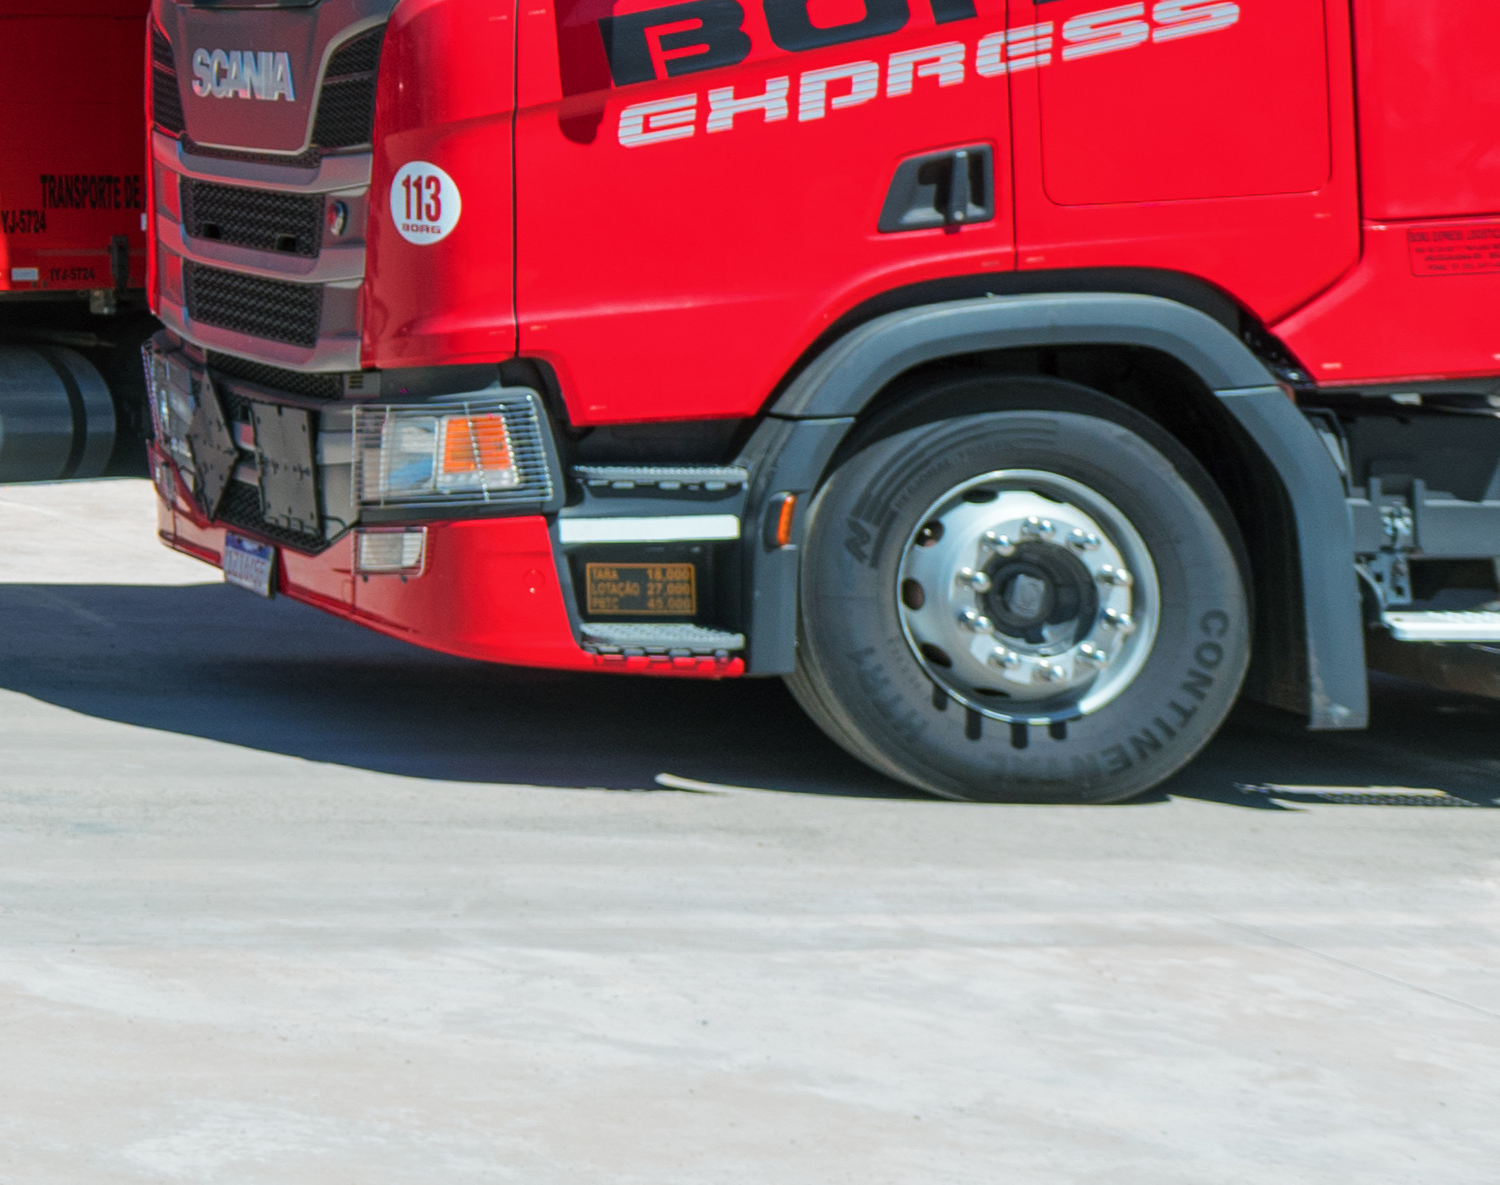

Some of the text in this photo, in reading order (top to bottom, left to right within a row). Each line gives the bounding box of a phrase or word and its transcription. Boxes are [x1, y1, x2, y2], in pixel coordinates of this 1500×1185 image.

[192, 47, 296, 102] SCANIA
[40, 174, 140, 210] TRANSPORTE DE
[401, 174, 442, 222] 113
[401, 223, 442, 235] BORG
